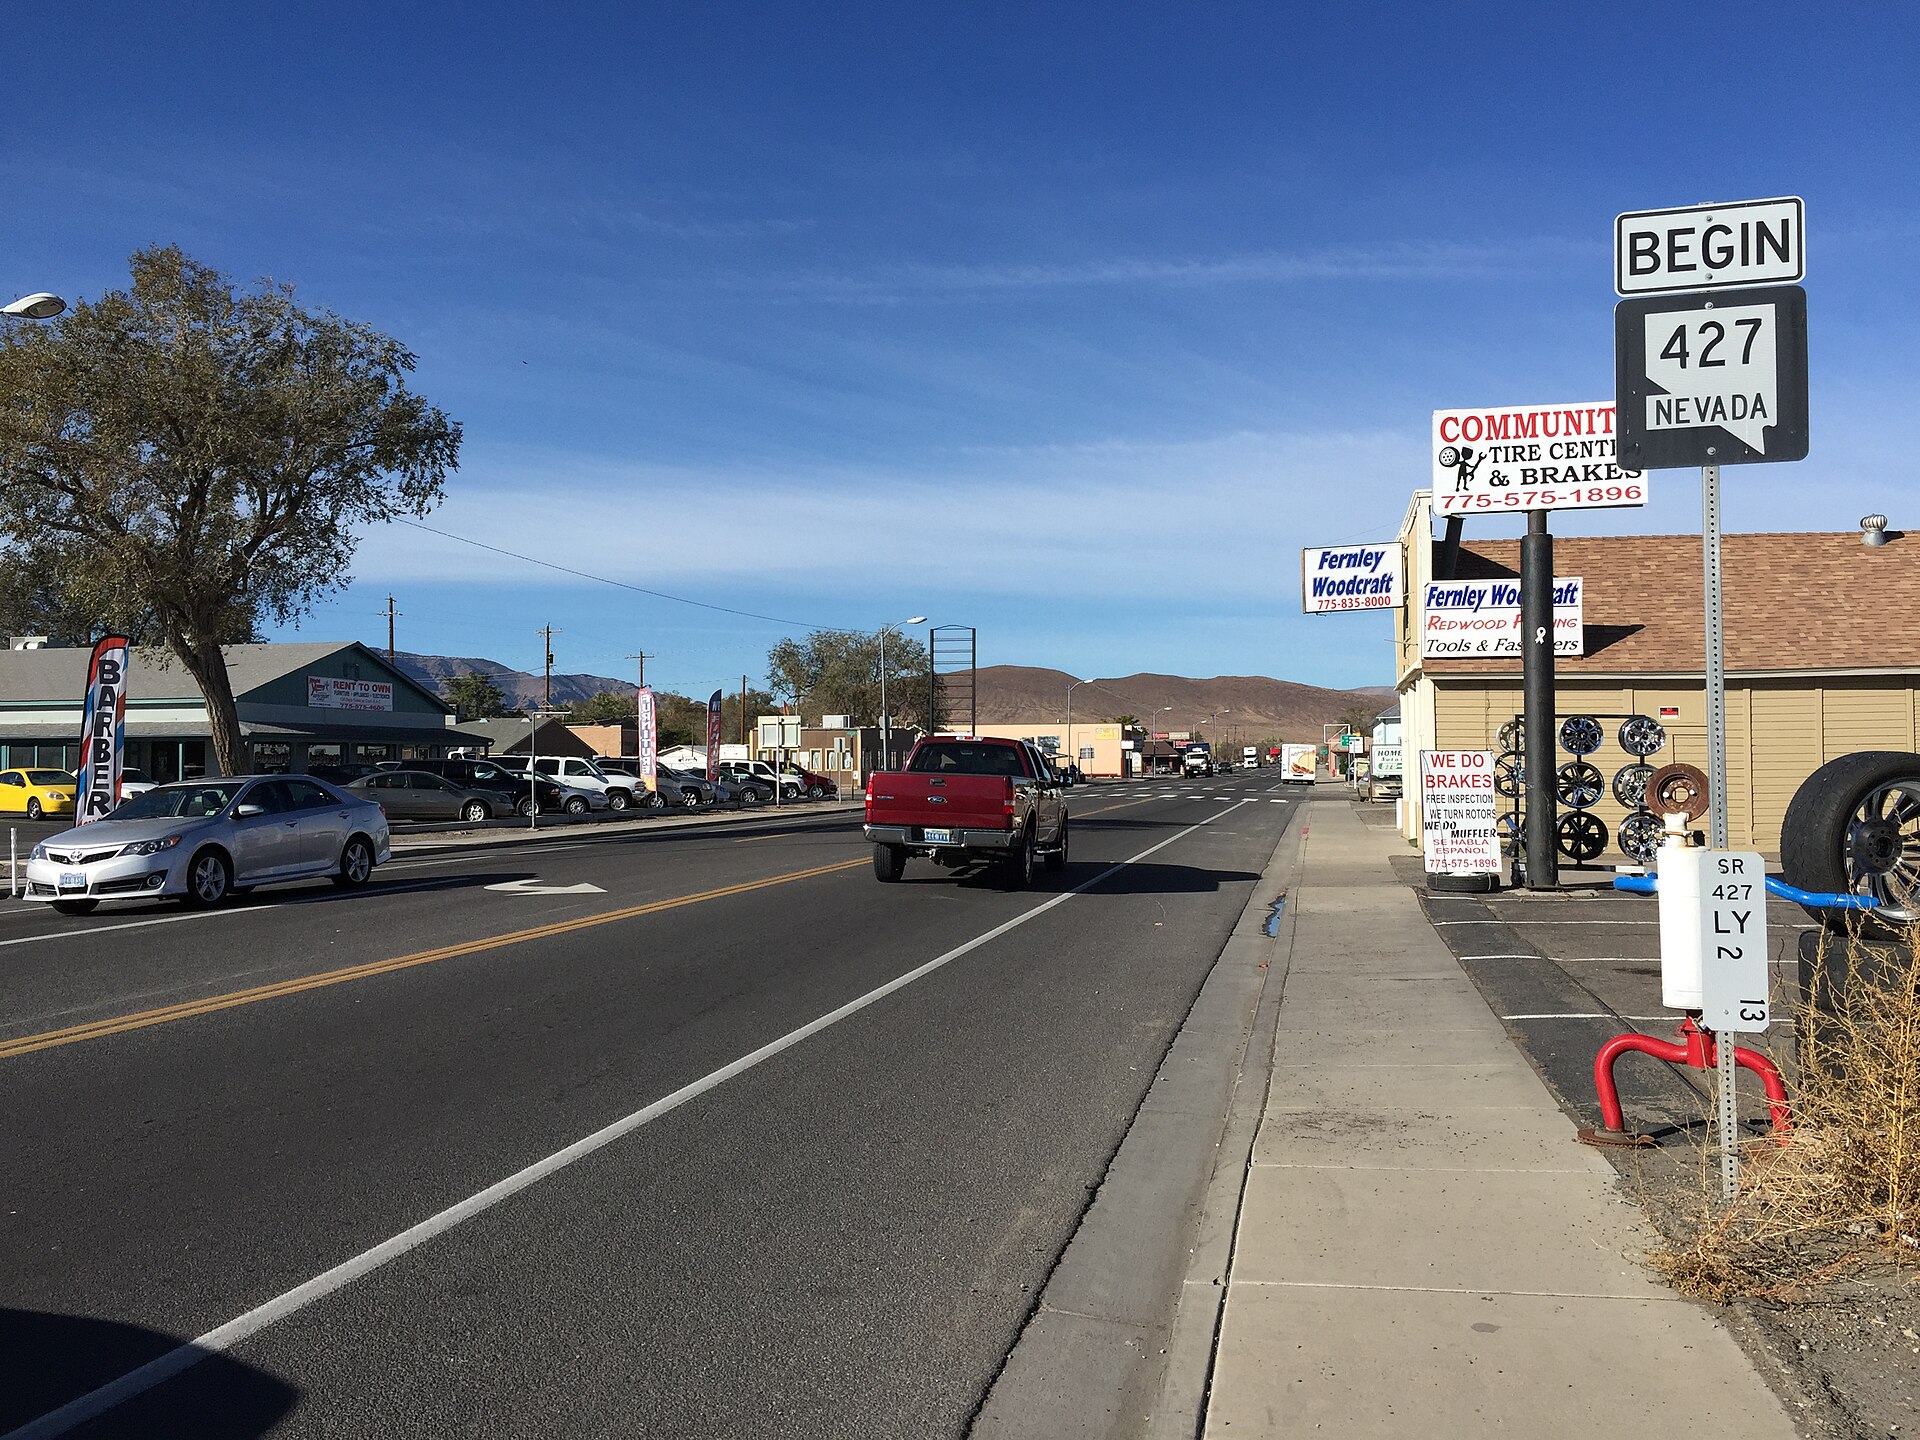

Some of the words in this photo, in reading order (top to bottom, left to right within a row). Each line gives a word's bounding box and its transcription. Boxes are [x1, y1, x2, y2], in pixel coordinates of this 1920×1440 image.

[1629, 218, 1790, 276] BEGIN
[1660, 318, 1762, 369] 427
[1656, 393, 1768, 426] NEVADA
[1440, 407, 1615, 443] COMMUNIT
[1488, 444, 1541, 463] TIRE
[1549, 438, 1615, 460] CENT
[1489, 470, 1510, 487] &
[1441, 486, 1642, 509] 775-575-1896
[1318, 548, 1387, 573] Fernley
[1312, 572, 1394, 597] Woodcraft
[1318, 596, 1391, 610] 775-835-8000
[1426, 585, 1487, 613] Fernley
[1427, 615, 1507, 630] REDWOOD
[1427, 639, 1471, 653] Tools
[1476, 640, 1489, 652] &
[333, 681, 356, 691] RENT
[359, 683, 370, 692] TO
[372, 684, 391, 693] OWN
[87, 660, 121, 816] BARBER
[1430, 754, 1456, 768] WE
[1461, 754, 1484, 768] DO
[1425, 774, 1492, 789] BRAKES
[1426, 794, 1446, 804] FREE
[1448, 794, 1493, 804] INSPECTION
[1430, 809, 1442, 819] WE
[1443, 809, 1464, 819] TURN
[1466, 809, 1497, 819] ROTORS
[1424, 821, 1440, 831] WE
[1442, 821, 1457, 830] DO
[1451, 828, 1497, 839] MUFFLER
[1435, 846, 1488, 854] ESPAÑOL
[1429, 859, 1498, 868] 775-575-1896
[1718, 858, 1745, 875] SR
[1711, 884, 1753, 901] 427
[1713, 911, 1752, 934] LY
[1717, 946, 1744, 960] 2
[1739, 999, 1766, 1022] 13
